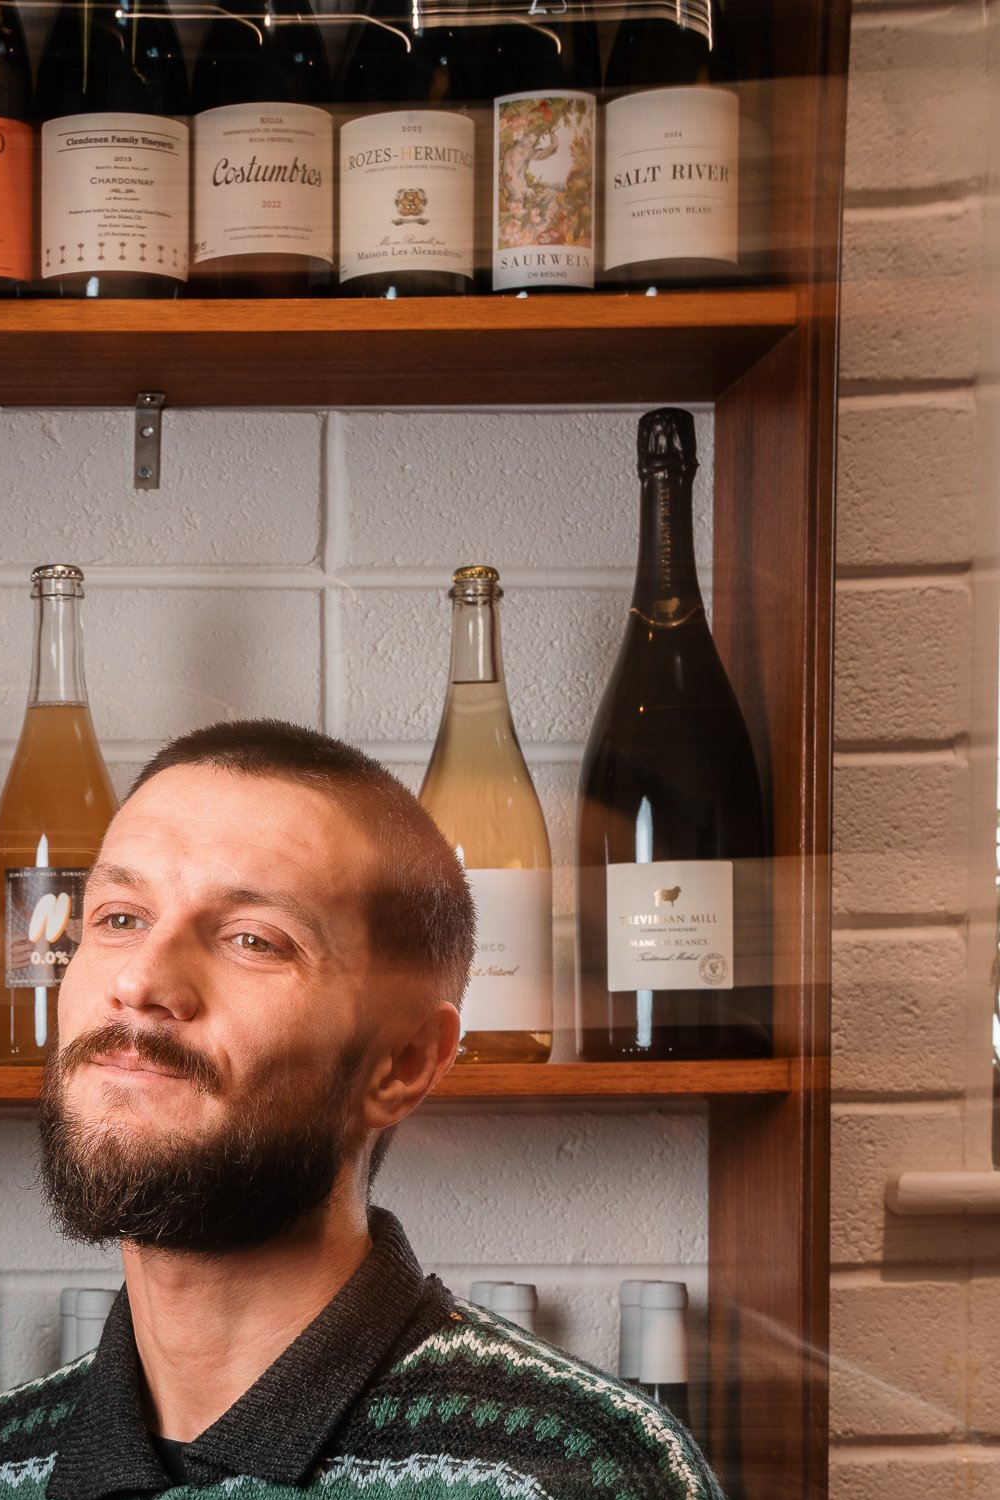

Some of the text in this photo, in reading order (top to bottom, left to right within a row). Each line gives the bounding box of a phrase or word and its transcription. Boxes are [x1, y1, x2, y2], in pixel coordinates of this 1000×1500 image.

[66, 135, 175, 150] Clendenen Family Vineyards
[212, 156, 323, 187] Costumbres
[614, 163, 729, 190] SALT RIVER
[90, 177, 155, 186] CHARDONNAY
[261, 200, 282, 208] 2022
[631, 206, 713, 218] SAUVIGNON BLANC
[357, 250, 388, 261] Maison
[391, 246, 408, 256] Les
[500, 253, 591, 270] SAURWEIN
[691, 914, 718, 924] MILL
[629, 939, 658, 948] BLANC
[675, 938, 708, 946] BLANCS
[30, 951, 70, 965] 0.0%
